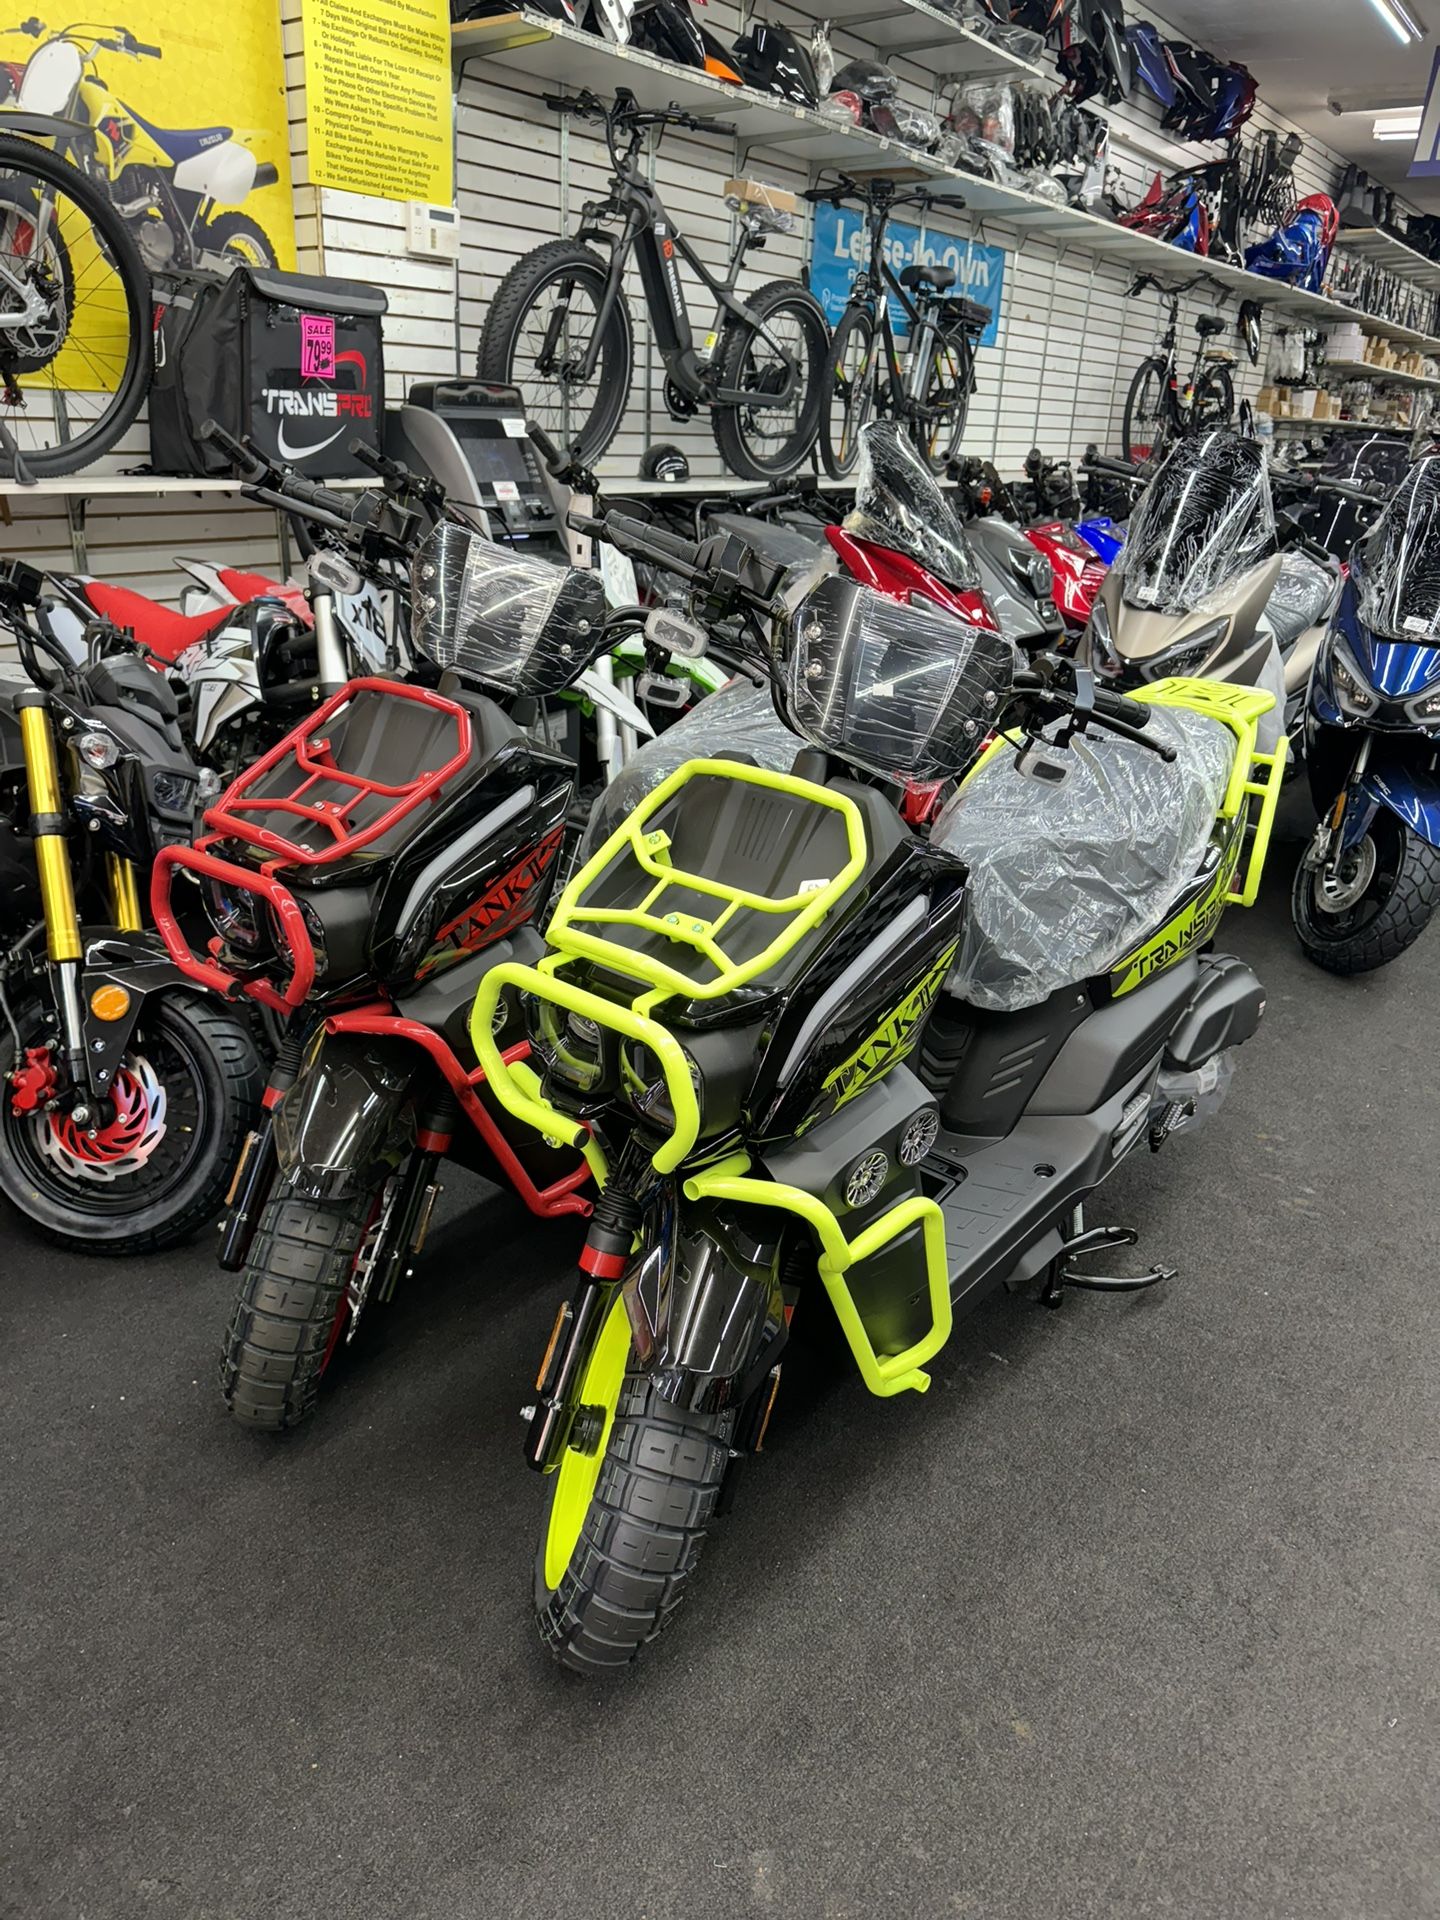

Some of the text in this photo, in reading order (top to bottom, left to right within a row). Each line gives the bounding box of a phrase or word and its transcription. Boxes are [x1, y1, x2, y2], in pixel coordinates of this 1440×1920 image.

[325, 10, 340, 21] Days
[341, 15, 354, 25] With
[355, 19, 377, 32] Original
[378, 26, 388, 35] Bill
[388, 29, 400, 39] And
[399, 33, 420, 45] Original
[432, 43, 444, 54] Only
[328, 0, 349, 13] Claims
[350, 7, 362, 17] And
[362, 10, 393, 26] Exchanges
[393, 20, 406, 31] Must
[415, 27, 429, 38] Made
[330, 33, 356, 47] Holidays.
[331, 22, 359, 38] Exchange
[368, 33, 390, 47] Returns
[424, 50, 443, 64] Sunday
[324, 53, 343, 65] Repair
[344, 59, 357, 69] Item
[357, 63, 369, 72] Left
[369, 66, 383, 76] Over
[333, 45, 343, 54] Are
[344, 48, 355, 57] Not
[355, 51, 372, 62] Liable
[373, 56, 383, 65] For
[383, 59, 394, 69] The
[394, 63, 408, 73] Loss
[415, 69, 435, 80] Receipt
[323, 75, 337, 85] Your
[338, 78, 356, 90] Phone
[365, 86, 381, 96] Other
[381, 90, 408, 104] Electronic
[408, 97, 426, 108] Device
[426, 102, 437, 113] May
[333, 67, 344, 76] Are
[345, 70, 355, 79] Not
[356, 72, 390, 88] Responsible
[390, 82, 400, 91] For
[400, 85, 411, 96] Any
[411, 88, 436, 101] Problems
[324, 86, 438, 122] Have Other Than The Specific Problem That
[334, 99, 349, 109] Were
[350, 103, 368, 114] Asked
[324, 118, 373, 137] Physical Damage.
[325, 107, 352, 122] Company
[361, 116, 376, 126] Store
[376, 120, 400, 134] Warranty
[401, 126, 415, 136] Does
[415, 130, 425, 138] Not
[425, 133, 443, 143] Include
[325, 129, 333, 137] All
[334, 131, 347, 141] Bike
[348, 134, 363, 144] Sales
[363, 138, 374, 147] Are
[397, 146, 420, 159] Warranty
[325, 139, 353, 154] Exchange
[354, 146, 366, 155] And
[375, 150, 397, 162] Refunds
[397, 156, 411, 165] Final
[411, 159, 423, 168] Sale
[423, 161, 432, 170] For
[325, 150, 431, 181] Bikes You Are Responsible For Anything
[326, 161, 339, 170] That
[339, 164, 364, 175] Happens
[364, 169, 379, 179] Once
[384, 173, 403, 184] Leaves
[403, 177, 414, 186] The
[336, 173, 348, 182] Sell
[348, 176, 381, 189] Refurbished
[381, 183, 392, 191] And
[393, 185, 404, 193] New
[404, 187, 429, 199] Products.
[307, 325, 332, 335] SALE
[433, 875, 527, 954] TANK
[826, 1006, 917, 1098] TANK
